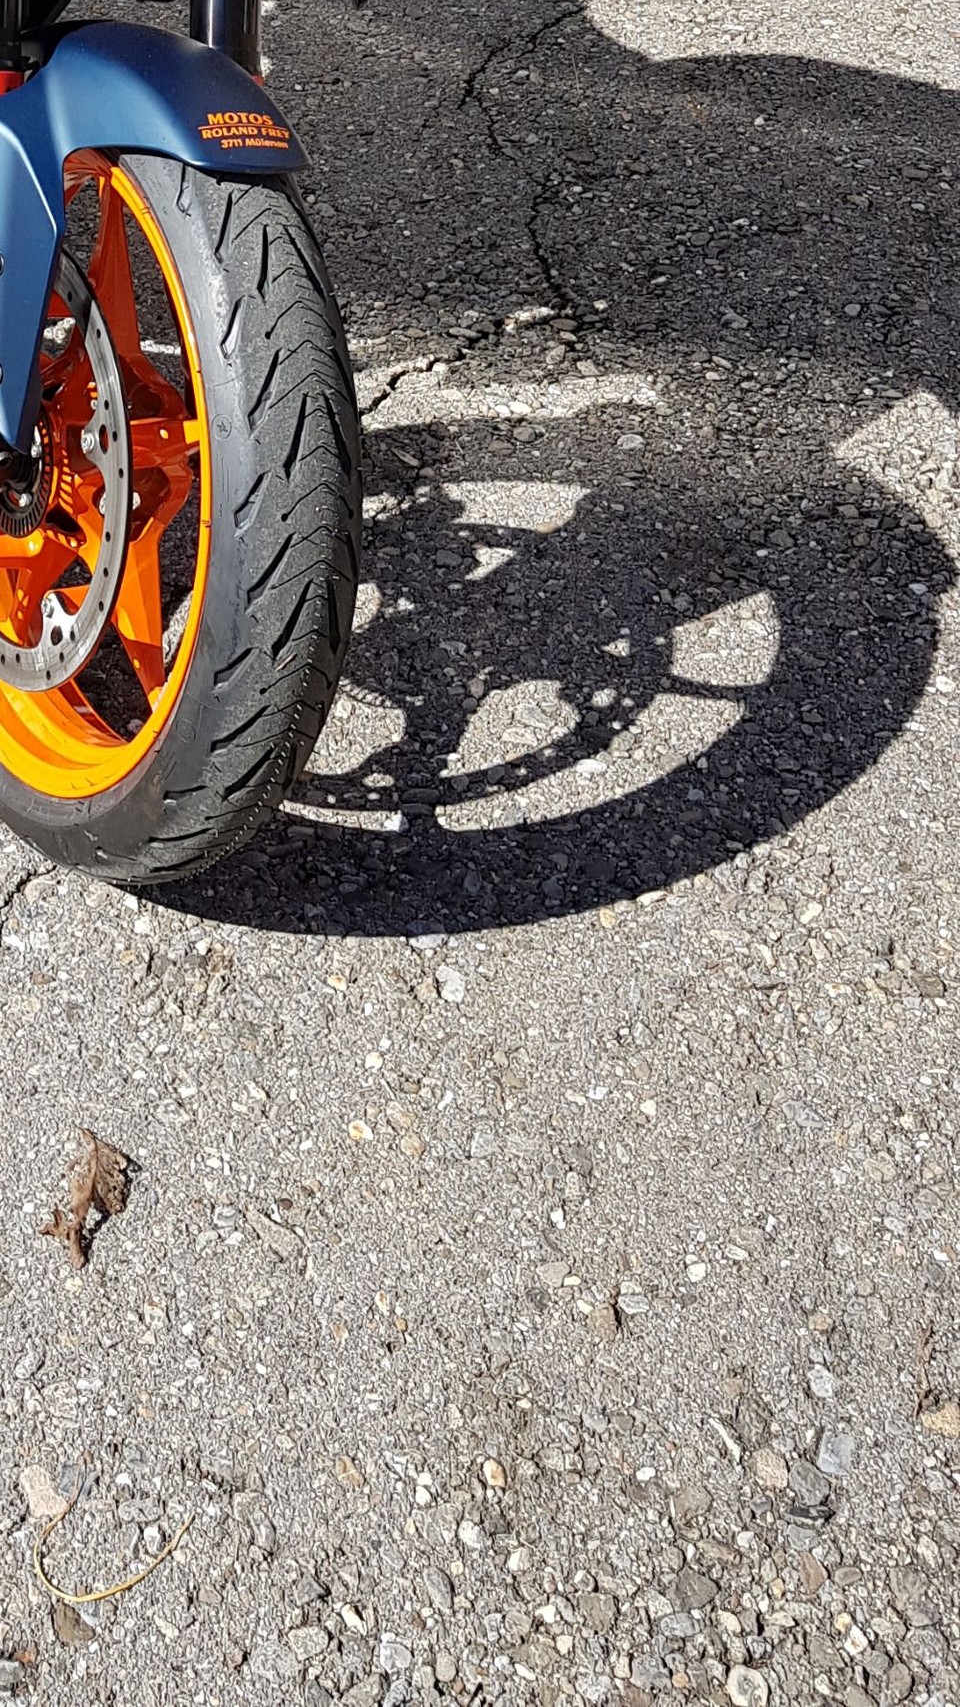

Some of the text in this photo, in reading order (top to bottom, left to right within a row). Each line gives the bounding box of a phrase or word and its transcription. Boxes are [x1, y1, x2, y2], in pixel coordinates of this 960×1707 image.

[207, 112, 273, 125] MOTOS
[201, 126, 290, 139] ROLAND FREY
[221, 139, 242, 148] 3711
